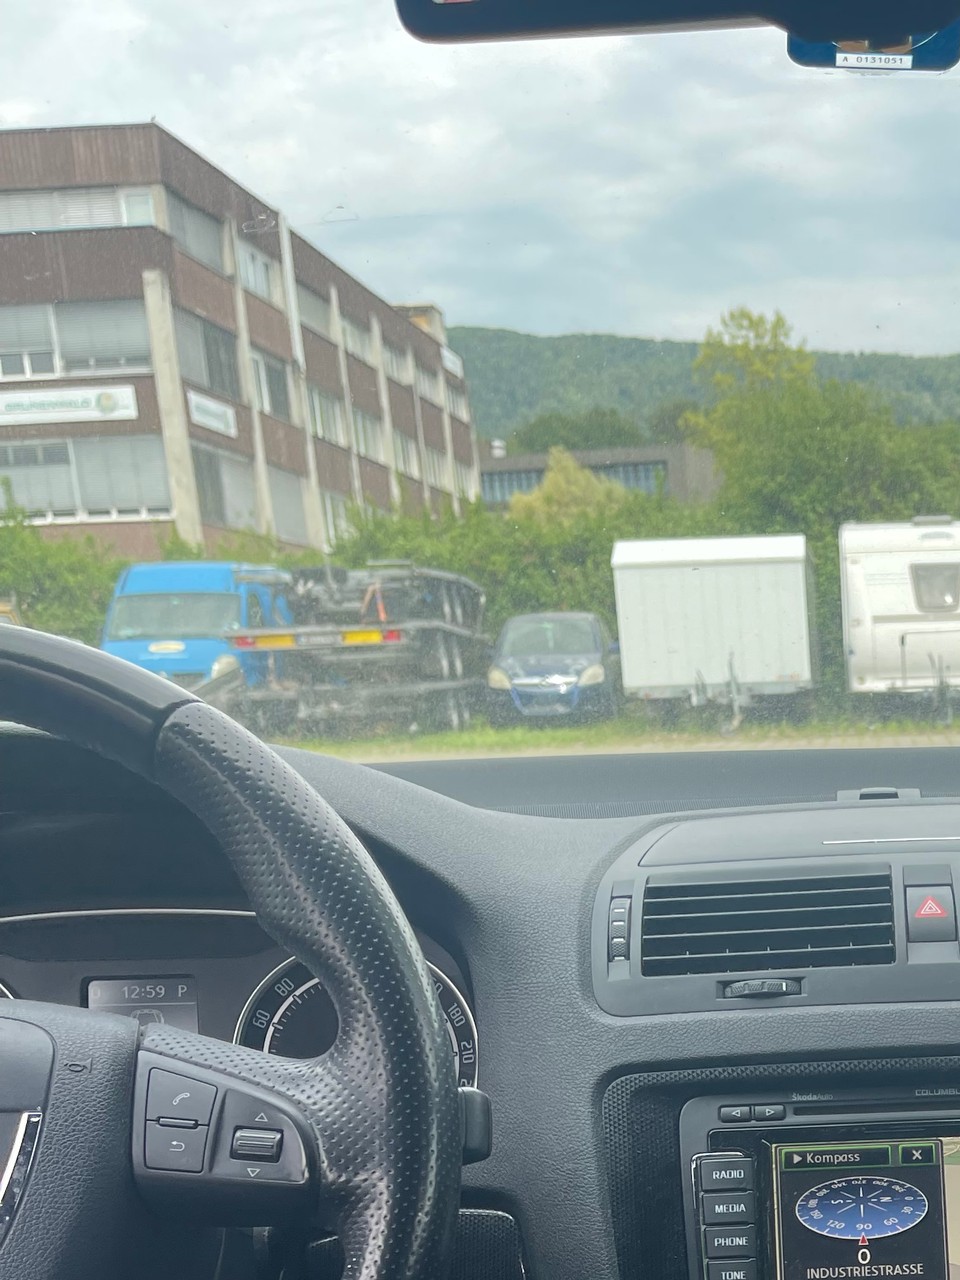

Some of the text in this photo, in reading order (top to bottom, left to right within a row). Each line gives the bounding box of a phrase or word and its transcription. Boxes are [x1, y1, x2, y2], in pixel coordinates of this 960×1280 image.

[856, 56, 903, 65] 0131051
[121, 984, 188, 999] 12:59 P
[274, 977, 295, 997] 80
[252, 1009, 271, 1029] 60
[447, 1002, 466, 1027] 180
[460, 1039, 475, 1064] 210
[806, 1152, 861, 1165] Kompass
[712, 1169, 745, 1180] RADIO
[715, 1203, 746, 1214] MEDIA
[827, 1220, 845, 1230] 120
[855, 1223, 873, 1231] 90
[714, 1237, 749, 1247] PHONE
[720, 1271, 746, 1280] TONE
[806, 1263, 924, 1279] INDUSTRIESTRASSE
